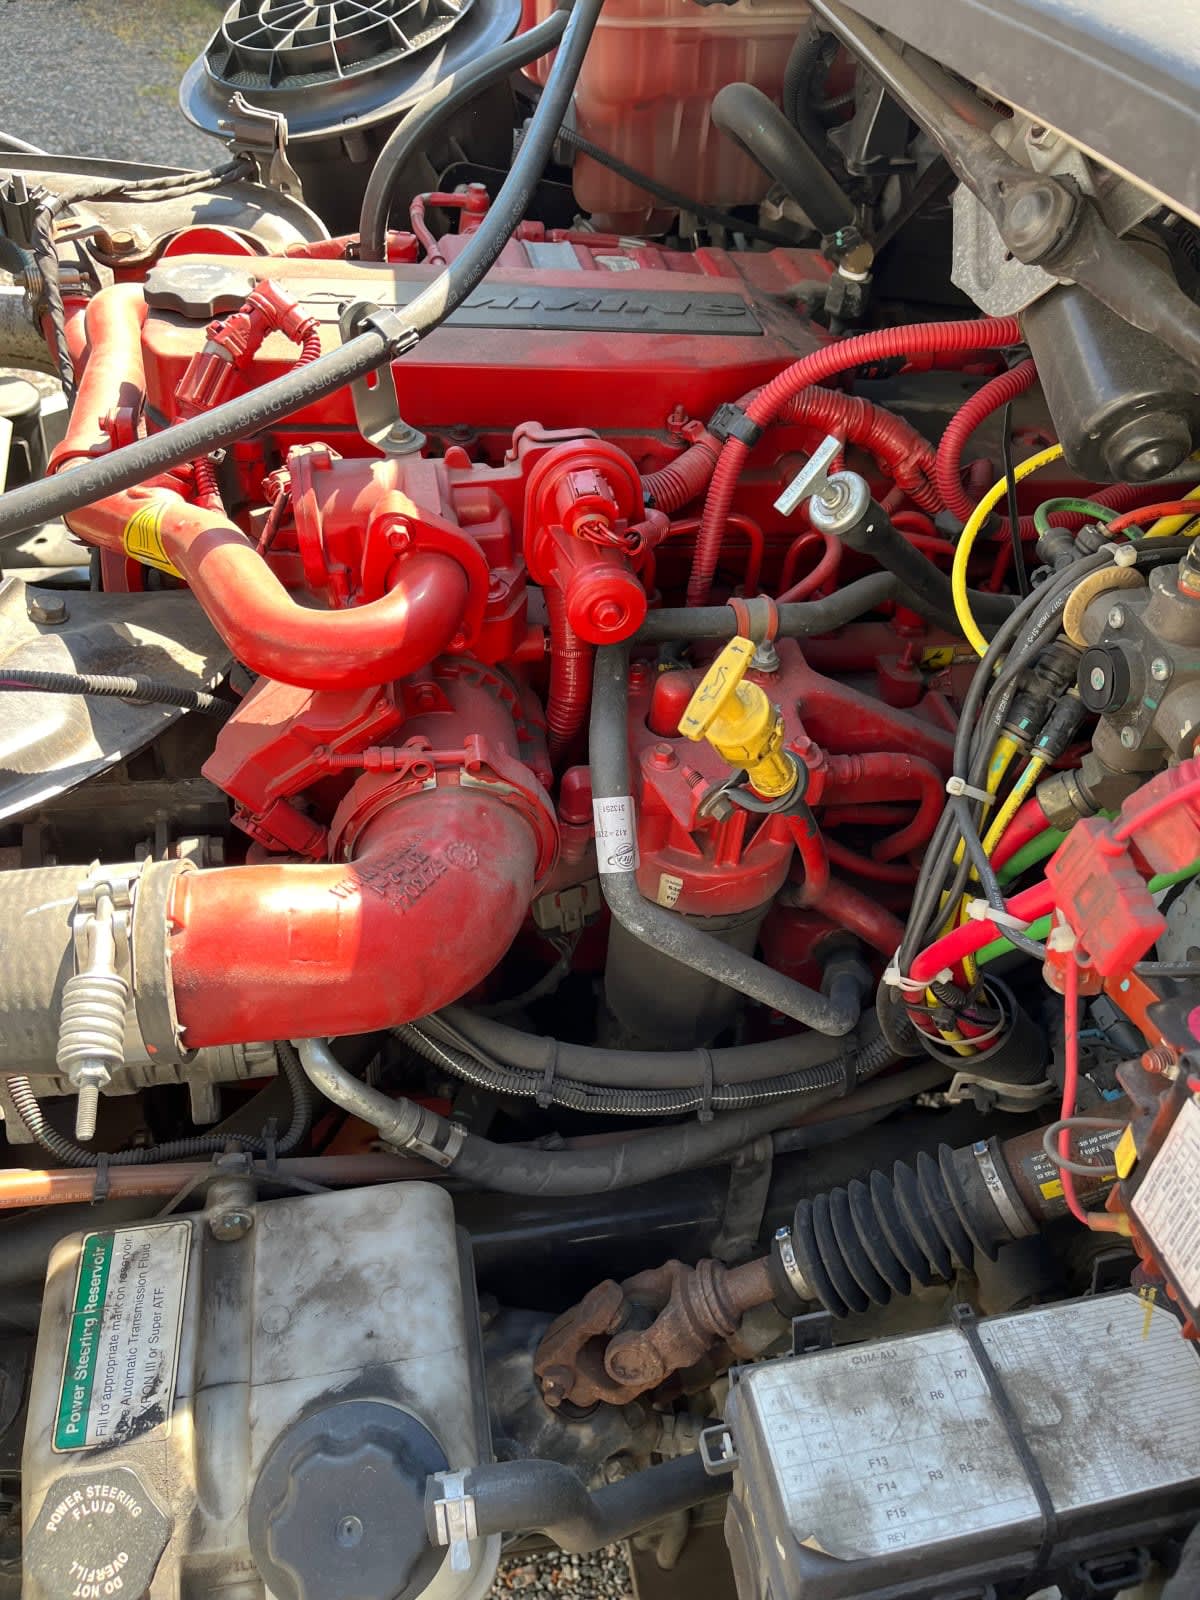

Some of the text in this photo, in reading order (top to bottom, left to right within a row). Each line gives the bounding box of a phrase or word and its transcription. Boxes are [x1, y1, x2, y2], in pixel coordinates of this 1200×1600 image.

[339, 357, 367, 377] SAE
[129, 447, 172, 472] Made
[113, 463, 129, 478] in
[138, 1243, 151, 1270] Fluid
[116, 1287, 126, 1301] on
[111, 1303, 123, 1331] mark
[127, 1272, 146, 1345] Transmission
[149, 1311, 163, 1344] Super
[66, 1246, 106, 1434] Power Steering Reservoir
[149, 1347, 157, 1357] or
[102, 1333, 120, 1401] appropriate
[954, 1369, 967, 1379] R7
[121, 1347, 138, 1406] Automatic
[930, 1390, 945, 1400] R6
[99, 1403, 108, 1415] to
[854, 1407, 867, 1417] R1
[96, 1418, 107, 1436] Fill
[868, 1456, 889, 1469] F13
[959, 1463, 975, 1474] R5
[928, 1470, 944, 1481] R3
[877, 1481, 897, 1494] F14
[46, 1485, 142, 1532] POWER STEERING
[72, 1500, 116, 1520] FLUID
[886, 1507, 907, 1520] F15
[888, 1533, 907, 1544] REV
[68, 1552, 129, 1583] OVERFILL
[72, 1575, 124, 1599] DO NOT
